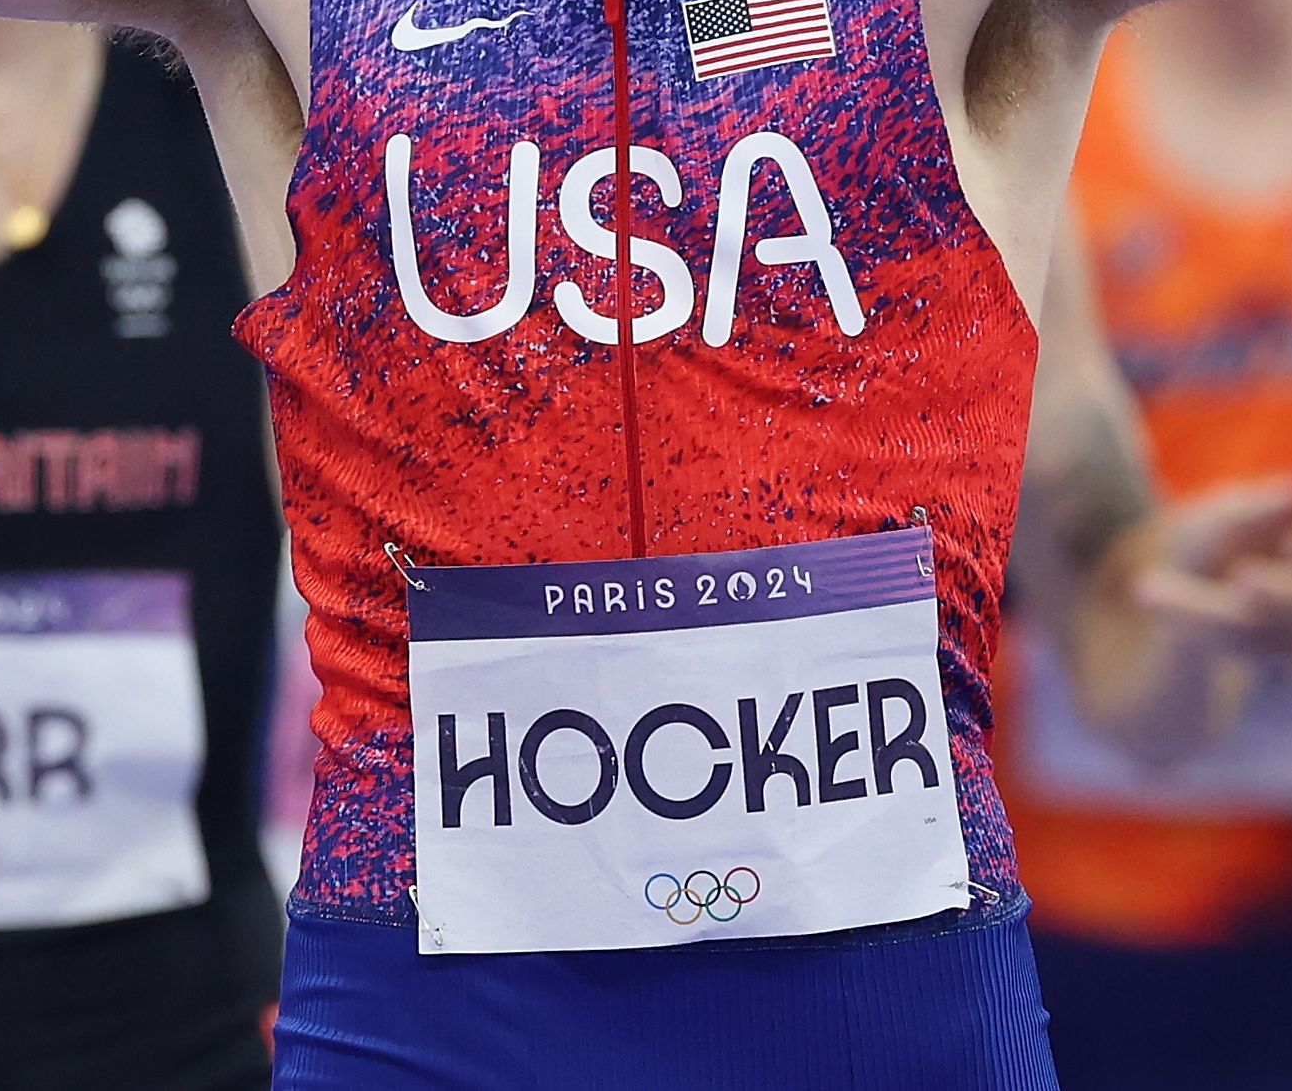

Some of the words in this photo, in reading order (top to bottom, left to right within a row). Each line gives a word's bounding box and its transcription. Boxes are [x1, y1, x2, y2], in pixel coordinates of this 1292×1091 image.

[385, 131, 864, 347] USA
[696, 566, 812, 607] 2024
[437, 677, 940, 828] HOCKER
